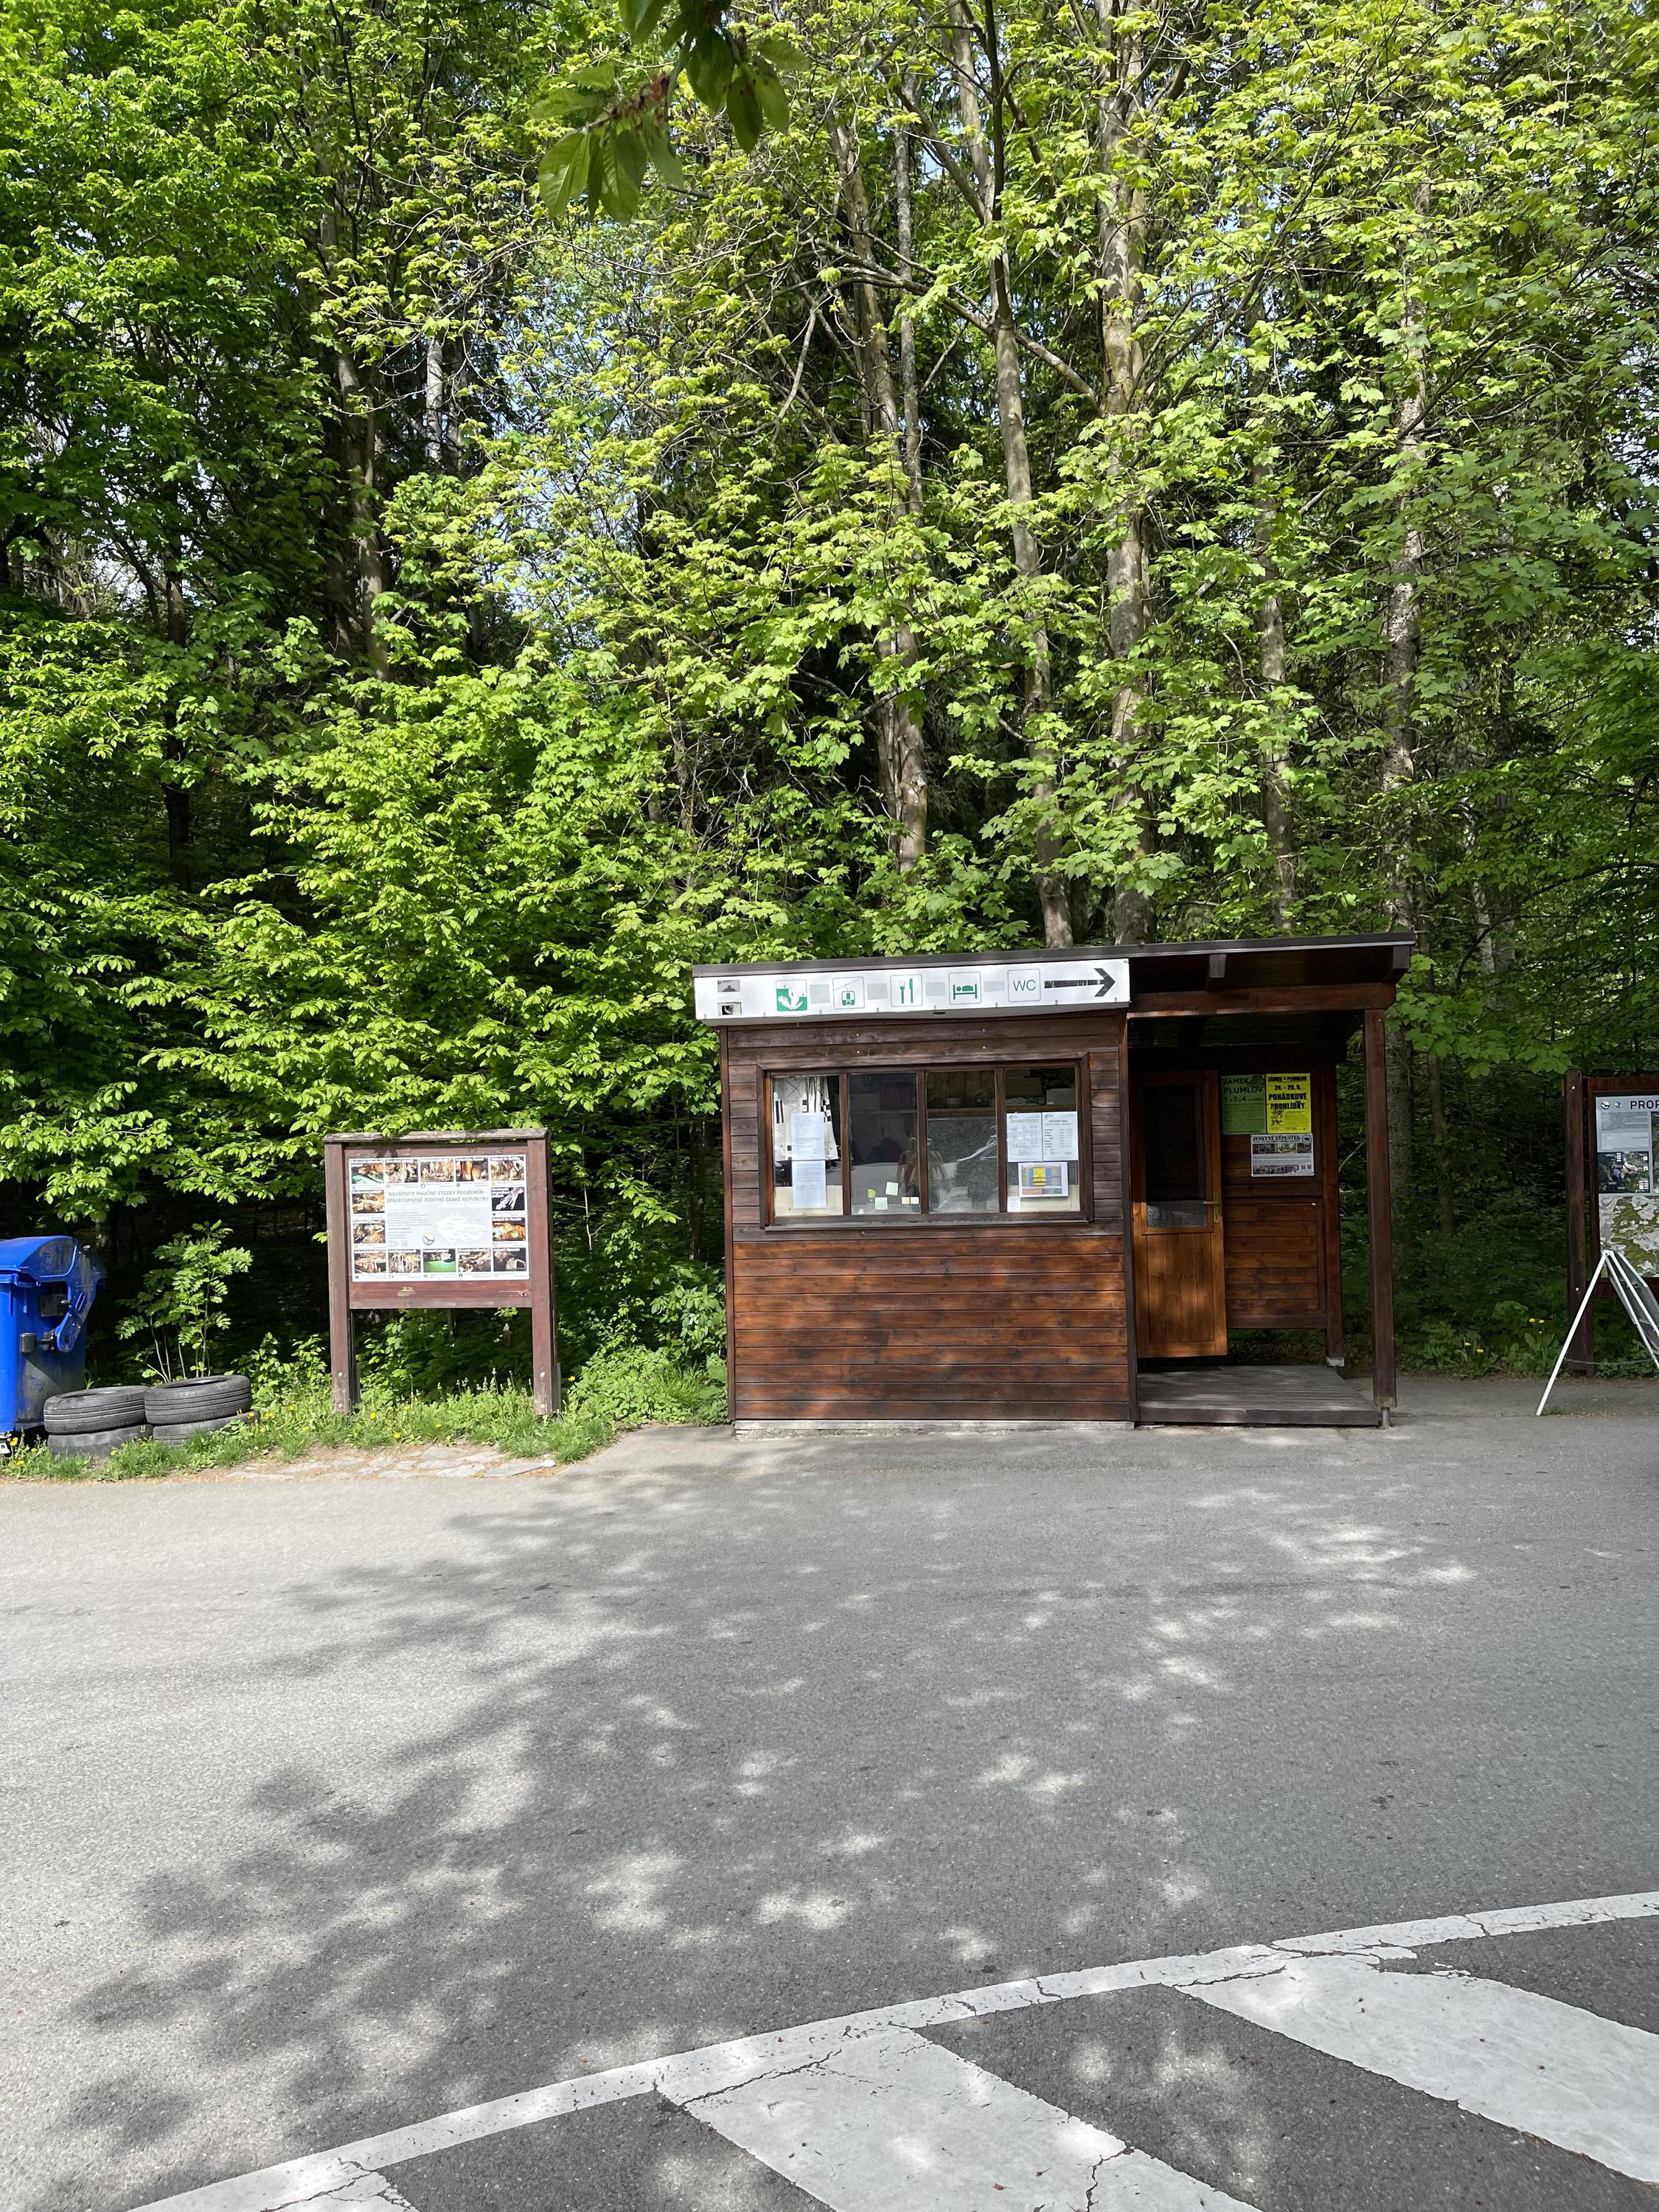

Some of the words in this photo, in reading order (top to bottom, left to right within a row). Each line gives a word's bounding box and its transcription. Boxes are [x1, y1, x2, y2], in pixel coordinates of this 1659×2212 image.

[1012, 979, 1037, 992] WC
[1223, 1085, 1264, 1093] PLUMLOV
[1268, 1092, 1307, 1100] POHÁDKOVÉ
[1270, 1101, 1305, 1109] PROHLÍDKY
